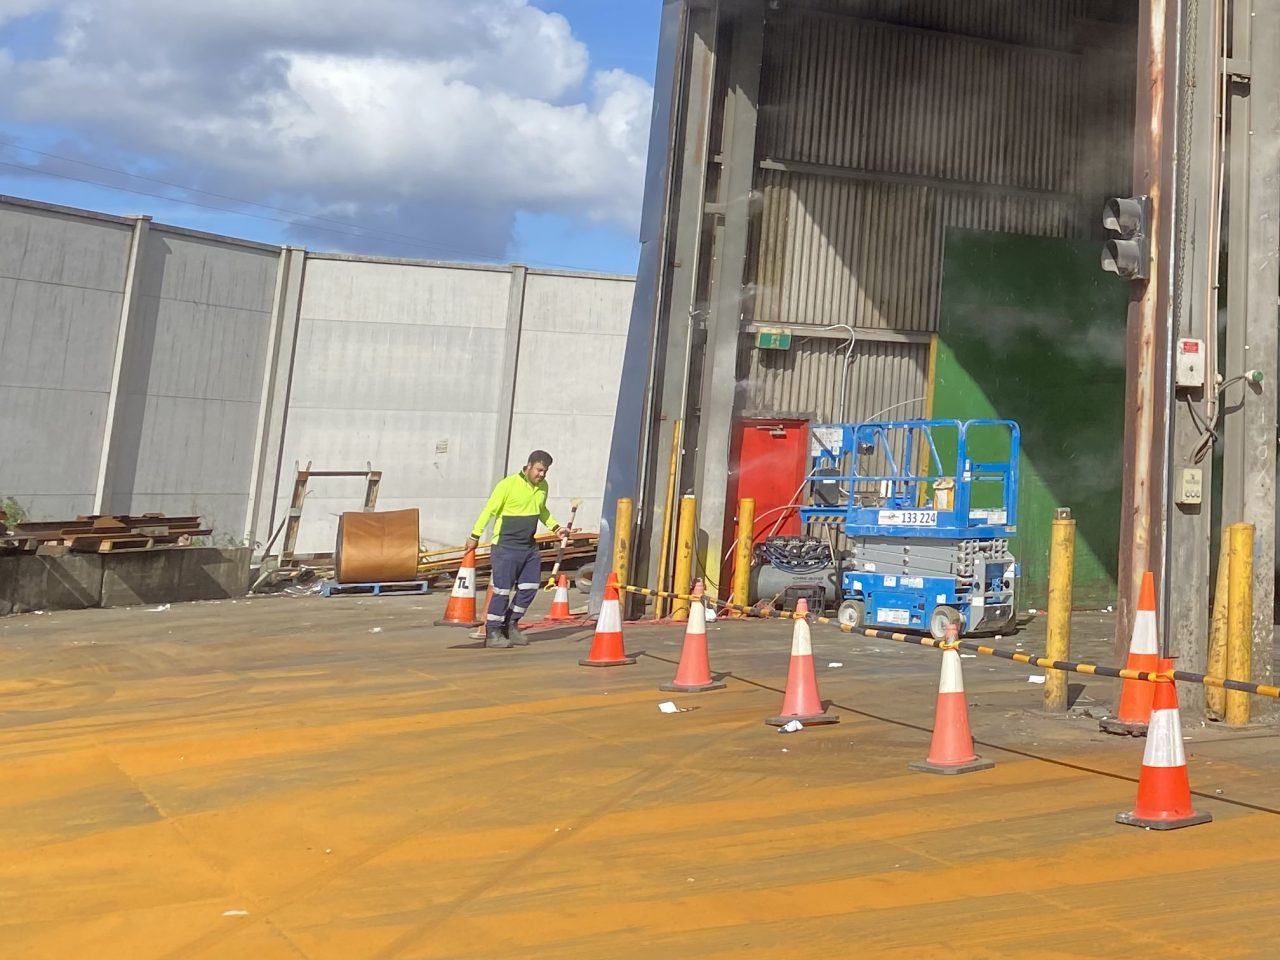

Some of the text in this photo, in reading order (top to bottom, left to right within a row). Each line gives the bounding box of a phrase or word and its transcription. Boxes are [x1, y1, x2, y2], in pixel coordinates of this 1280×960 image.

[902, 513, 917, 523] 133
[920, 513, 936, 523] 224
[457, 577, 469, 589] TL
